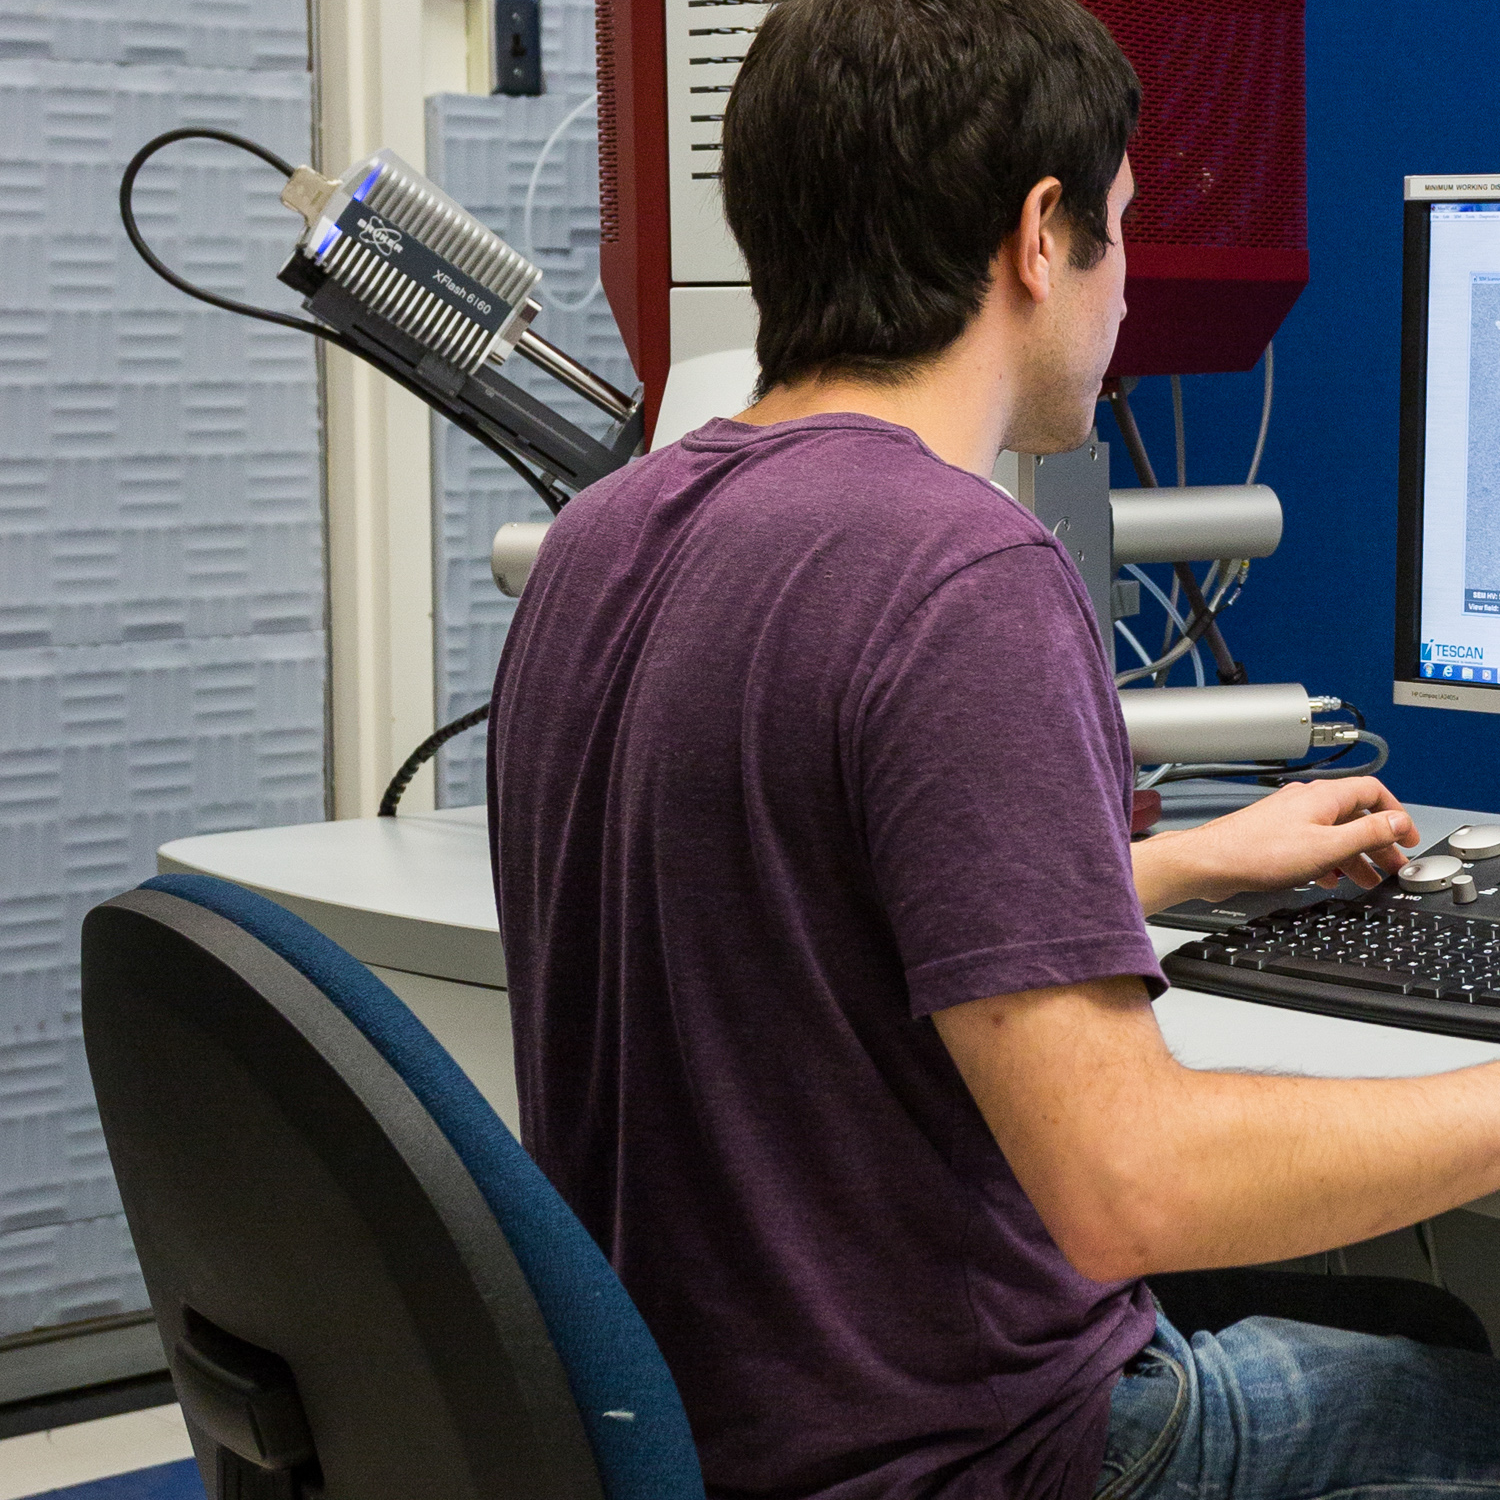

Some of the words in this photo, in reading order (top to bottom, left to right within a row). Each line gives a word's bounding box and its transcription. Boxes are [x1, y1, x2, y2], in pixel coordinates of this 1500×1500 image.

[1456, 183, 1488, 191] WORKING
[432, 269, 467, 299] XFlash
[1473, 591, 1486, 599] SEM
[1468, 603, 1482, 611] View
[1483, 604, 1499, 612] field:
[1435, 643, 1483, 660] TESCAN
